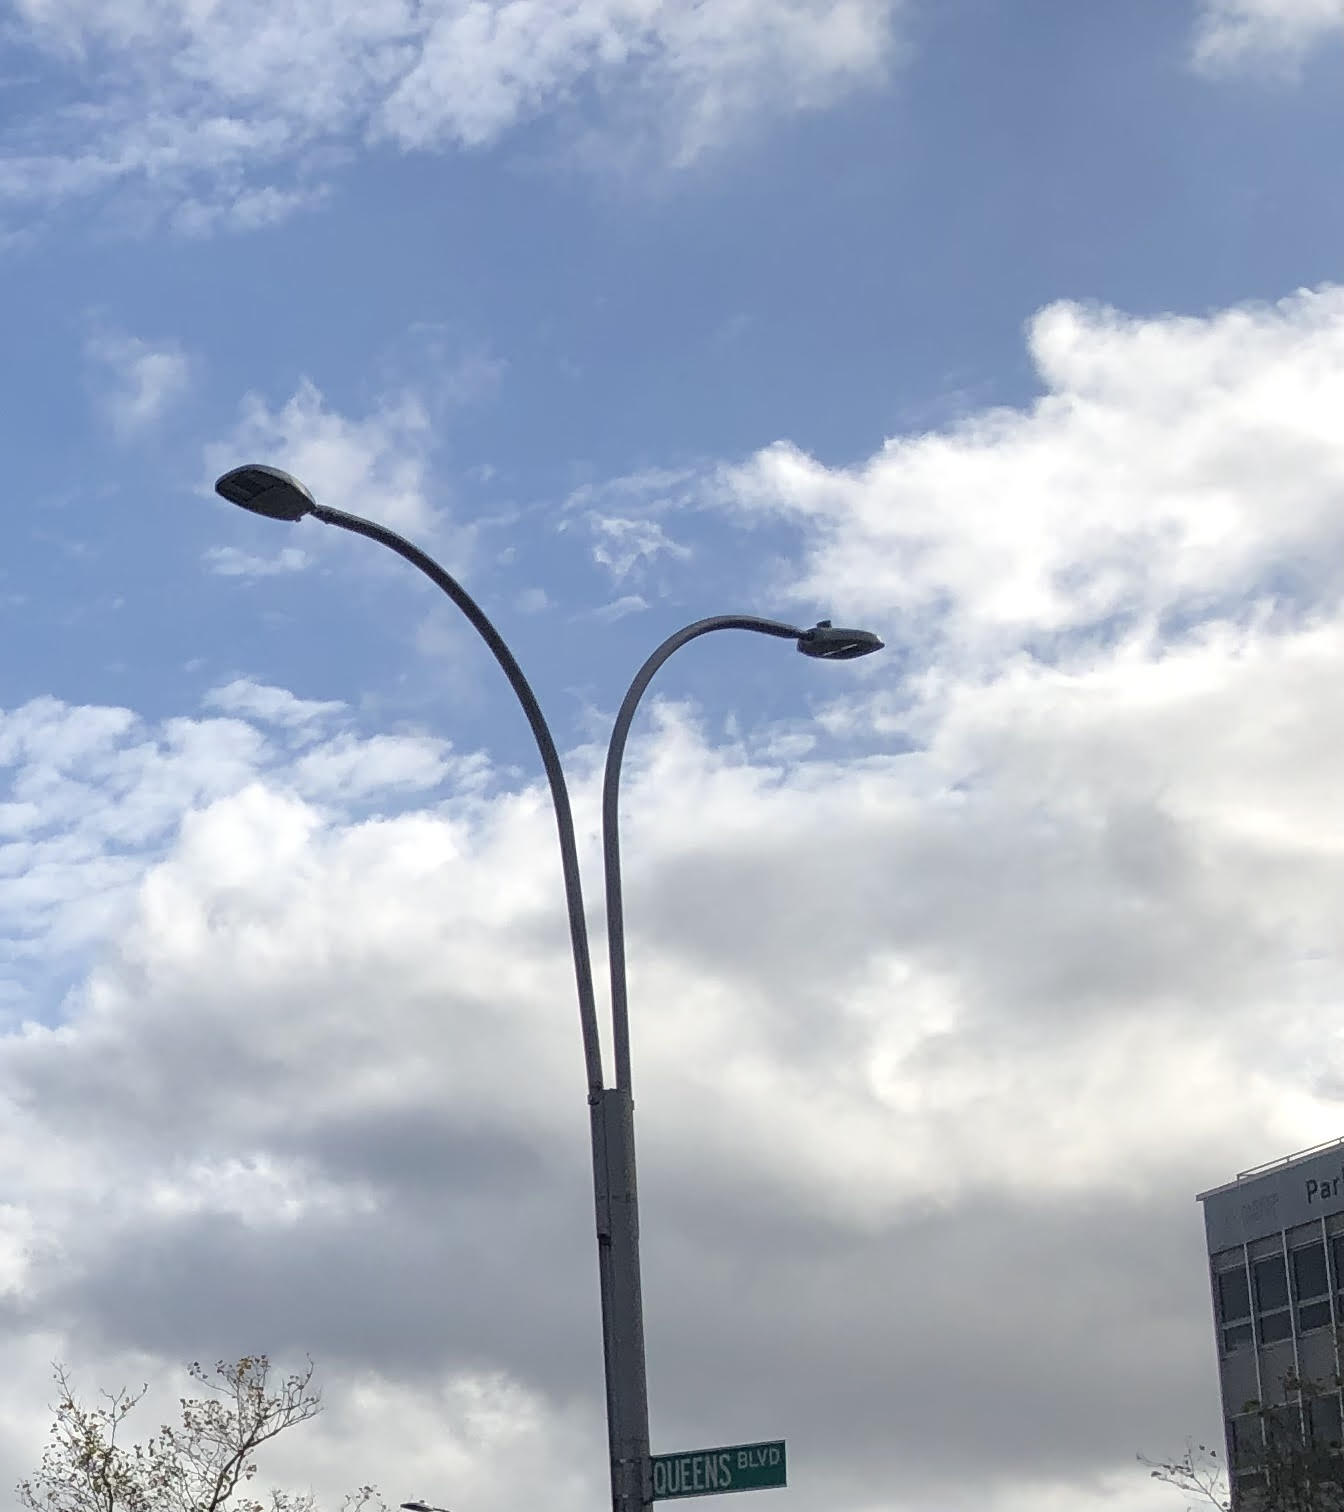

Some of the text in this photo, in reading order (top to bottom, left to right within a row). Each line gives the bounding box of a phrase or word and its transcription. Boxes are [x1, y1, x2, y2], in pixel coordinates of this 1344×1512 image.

[1305, 1168, 1344, 1204] Par
[653, 1448, 781, 1494] QUEENS BLVD
